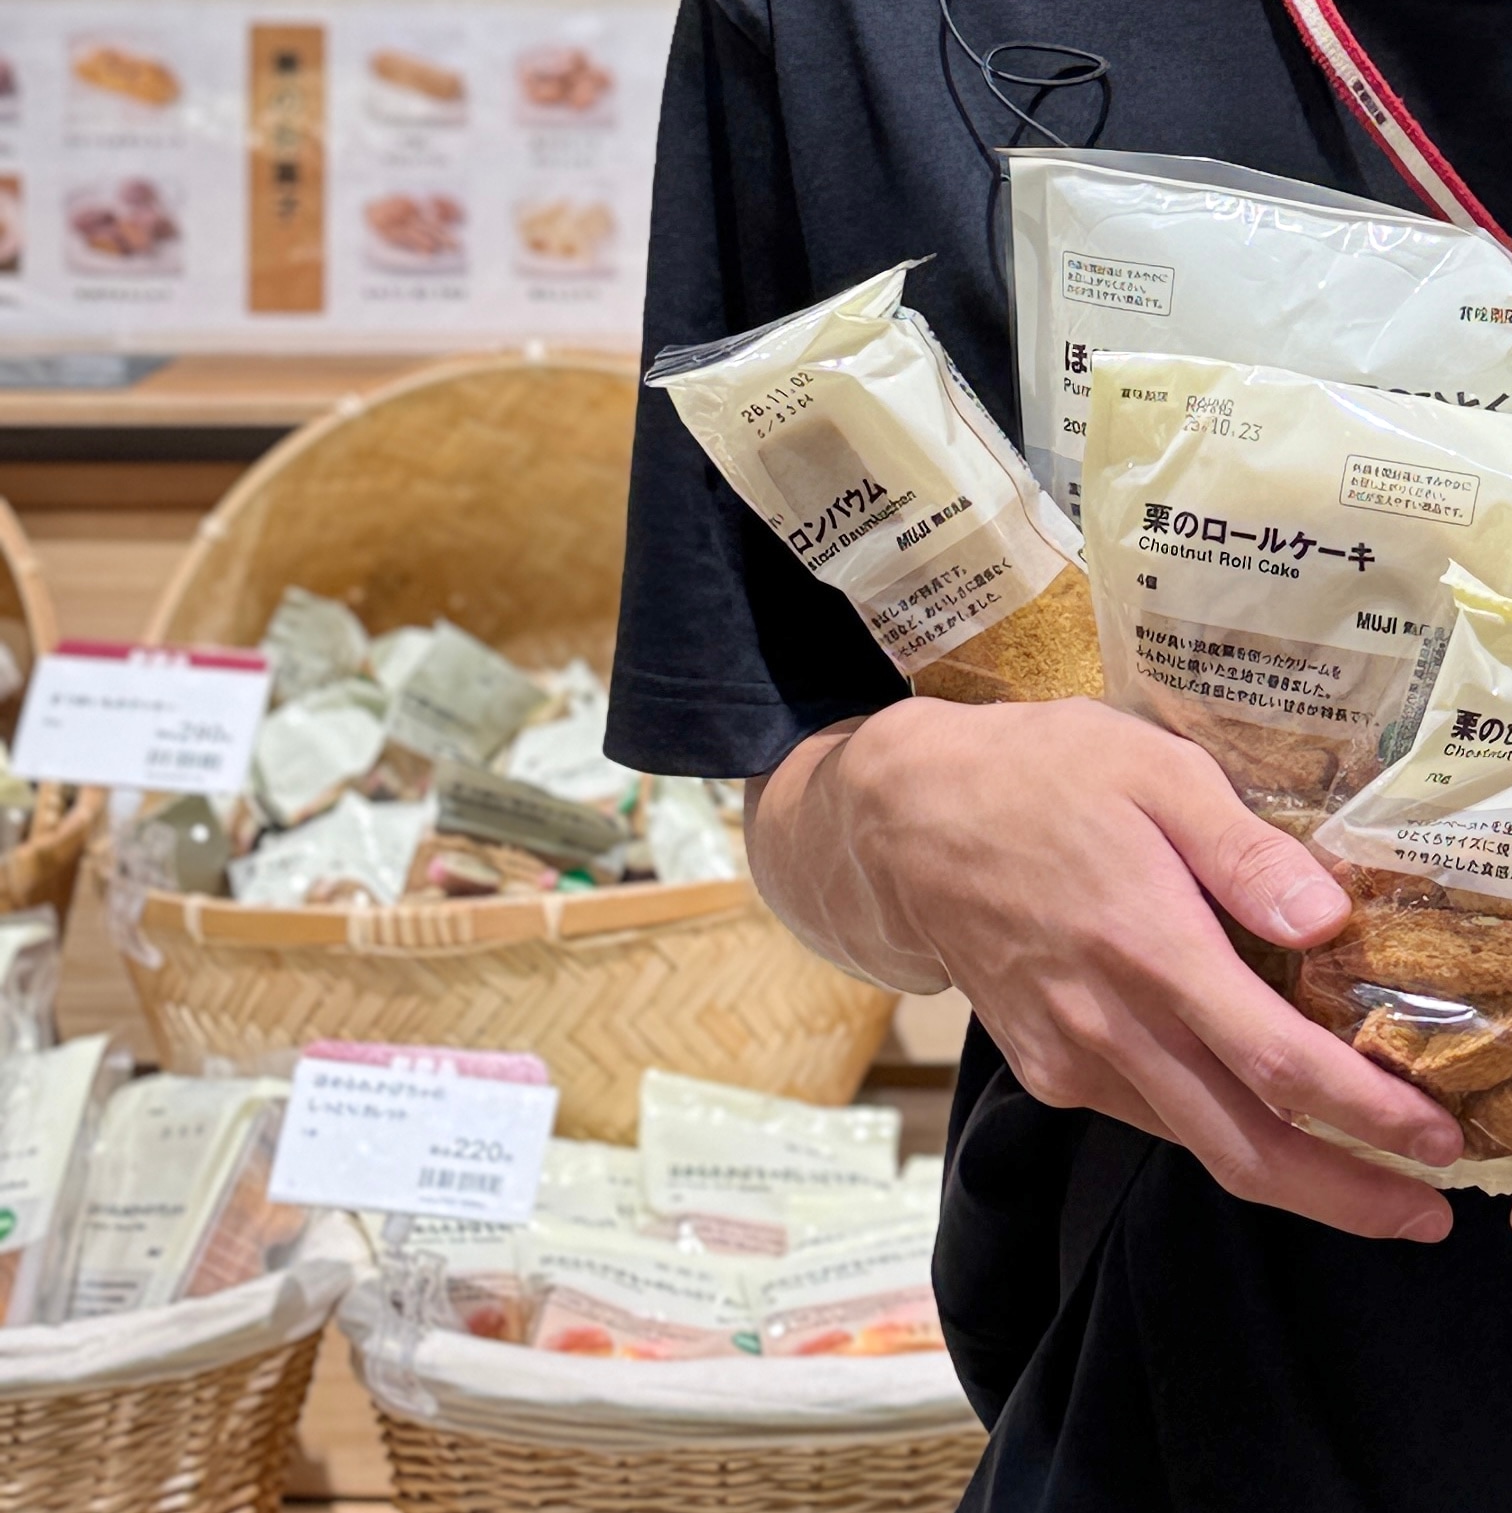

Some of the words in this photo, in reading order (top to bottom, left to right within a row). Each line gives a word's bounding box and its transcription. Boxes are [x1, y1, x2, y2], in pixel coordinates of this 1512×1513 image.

[895, 519, 932, 552] MUJI
[1142, 502, 1376, 572] 栗のロールケーキ
[1138, 535, 1213, 564] Chestnut
[1218, 551, 1253, 571] Roll
[1258, 560, 1301, 579] Cake
[1356, 611, 1399, 635] MUJI
